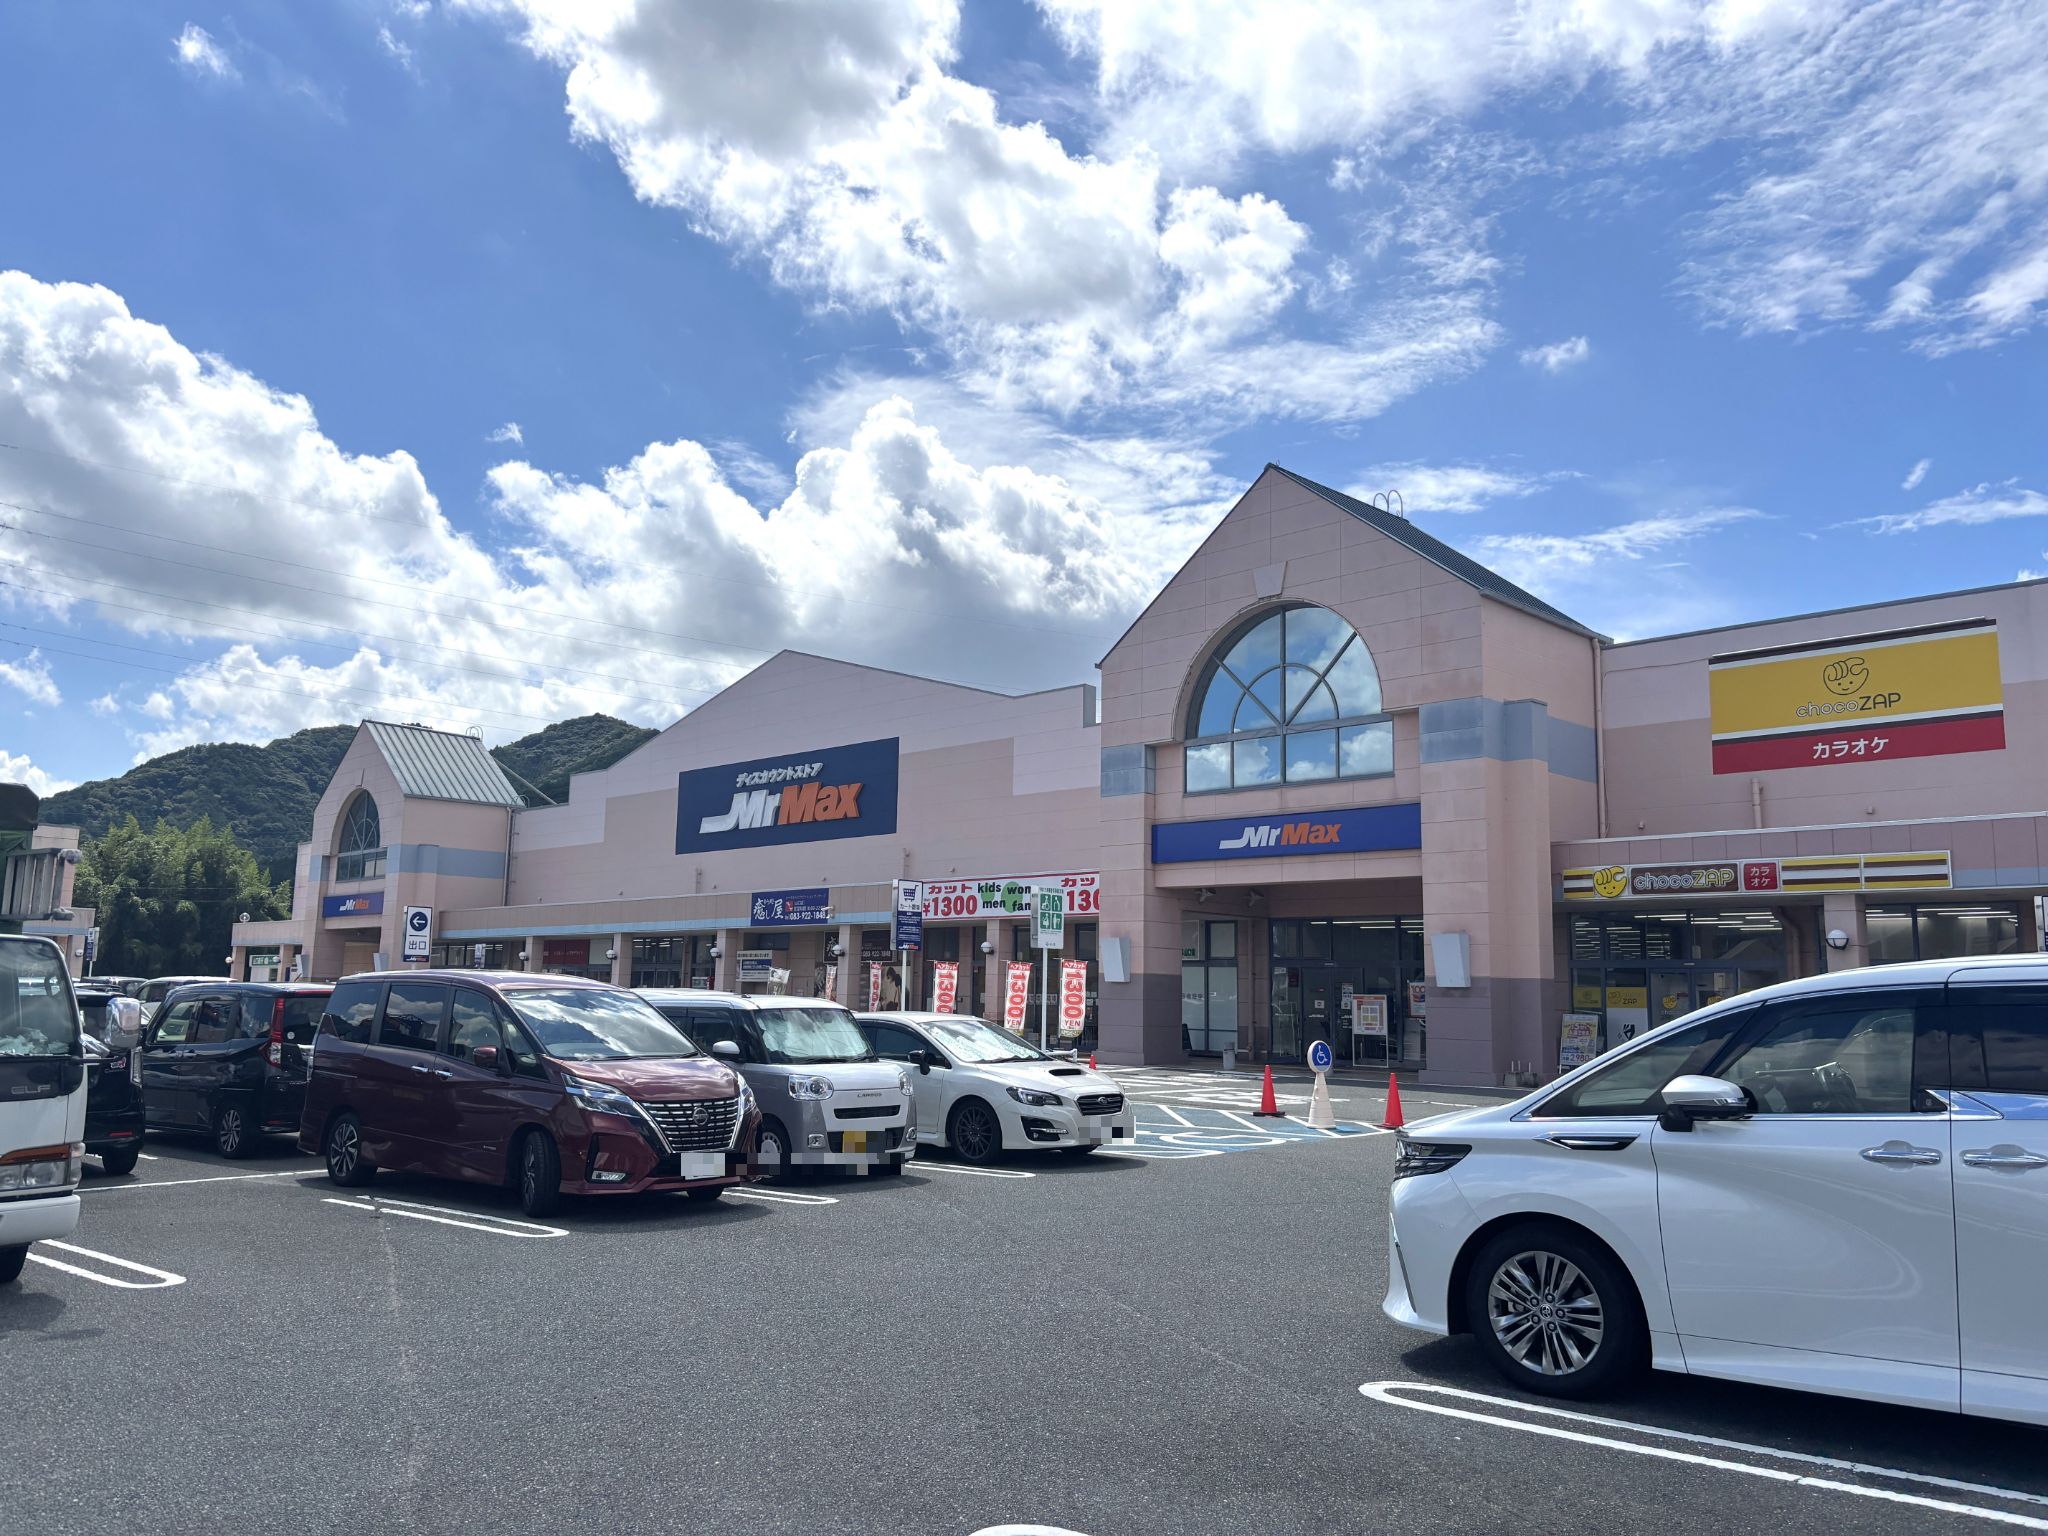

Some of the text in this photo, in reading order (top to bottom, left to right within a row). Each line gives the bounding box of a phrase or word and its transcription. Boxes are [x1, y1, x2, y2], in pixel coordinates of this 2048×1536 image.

[1796, 692, 1901, 718] chocoZAP
[1813, 736, 1889, 759] カラオケ
[736, 763, 823, 787] ディスカウントストア
[699, 781, 864, 834] MrMax
[1219, 822, 1341, 849] MrMax
[1634, 868, 1735, 890] chocoZAP
[1750, 866, 1770, 876] カラ
[1750, 877, 1771, 887] オケ
[928, 883, 973, 895] カット
[977, 881, 1002, 894] kids
[922, 894, 977, 917] ¥1300
[982, 898, 1006, 909] men
[408, 940, 427, 950] 出口
[1007, 972, 1026, 1018] 1300
[1064, 971, 1084, 1019] 1300
[1064, 1019, 1081, 1027] YEN
[11, 1084, 51, 1095] ELF
